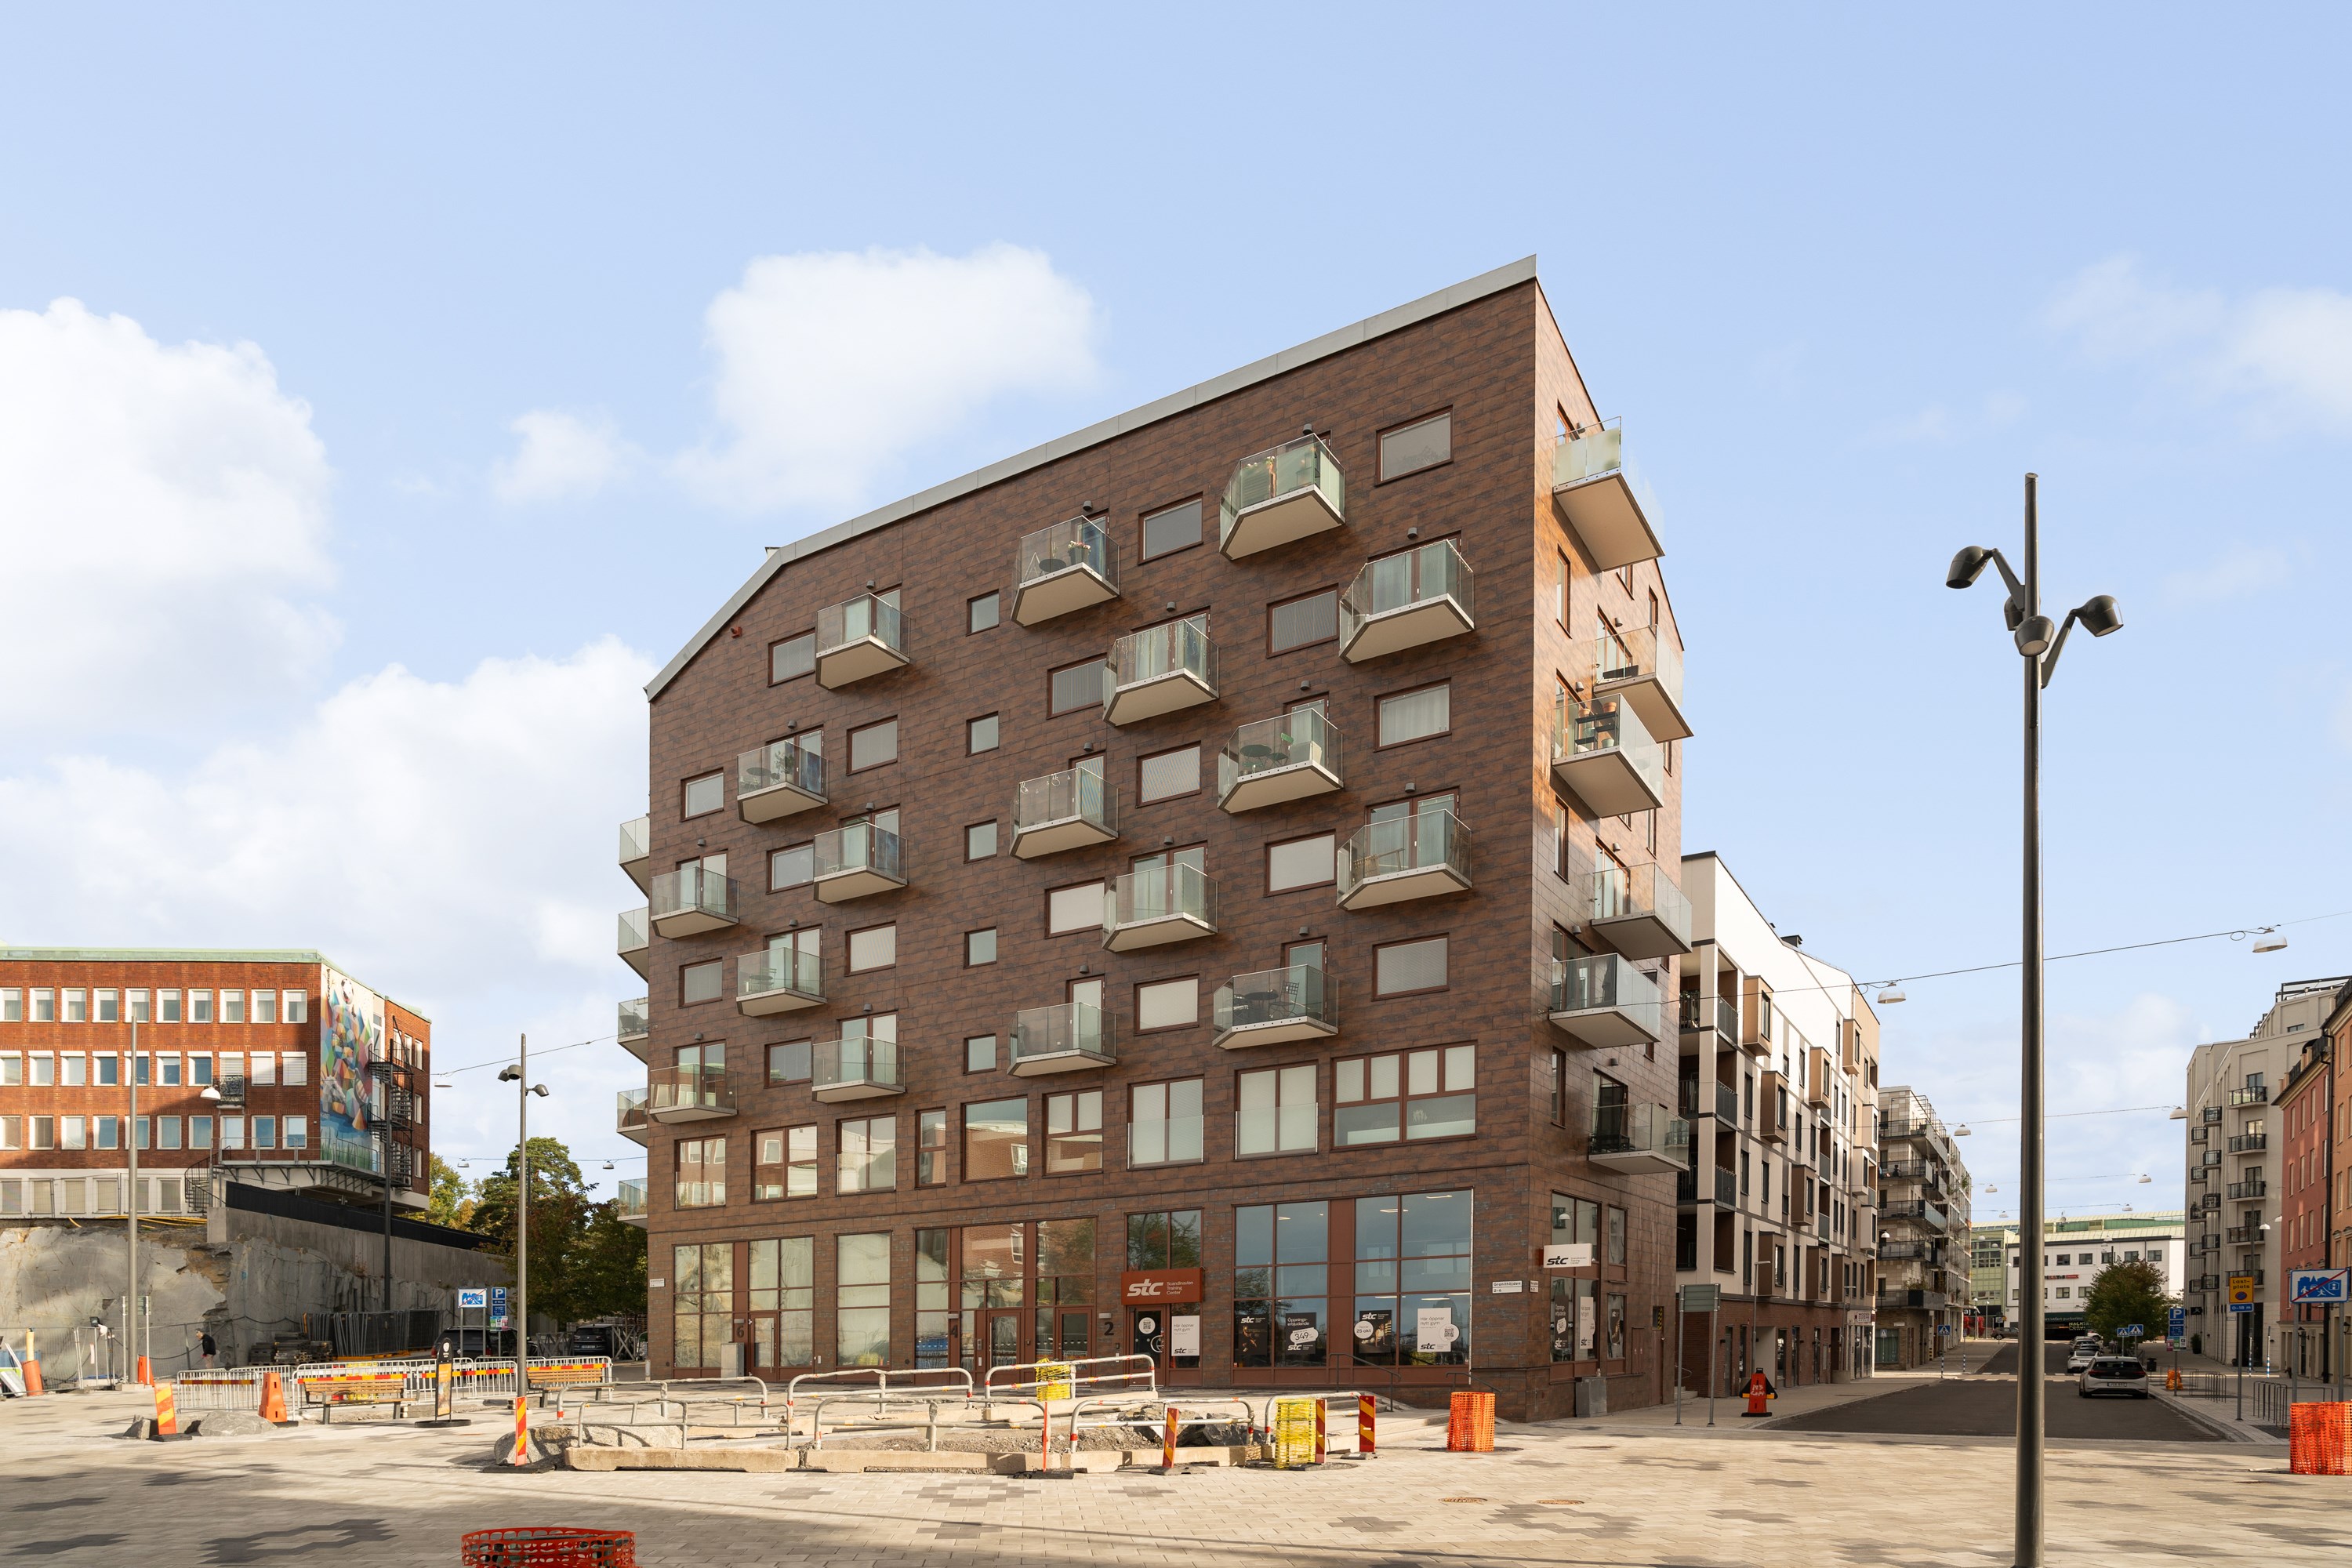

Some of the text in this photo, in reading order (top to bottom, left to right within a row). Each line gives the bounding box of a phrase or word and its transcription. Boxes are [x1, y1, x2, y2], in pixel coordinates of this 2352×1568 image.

[1546, 1256, 1569, 1265] stc
[495, 1288, 504, 1298] P
[1127, 1278, 1164, 1297] stc
[2173, 1309, 2182, 1319] P
[737, 1325, 744, 1338] 6
[949, 1324, 958, 1338] 4
[1104, 1321, 1114, 1336] 2
[1294, 1332, 1309, 1341] 349
